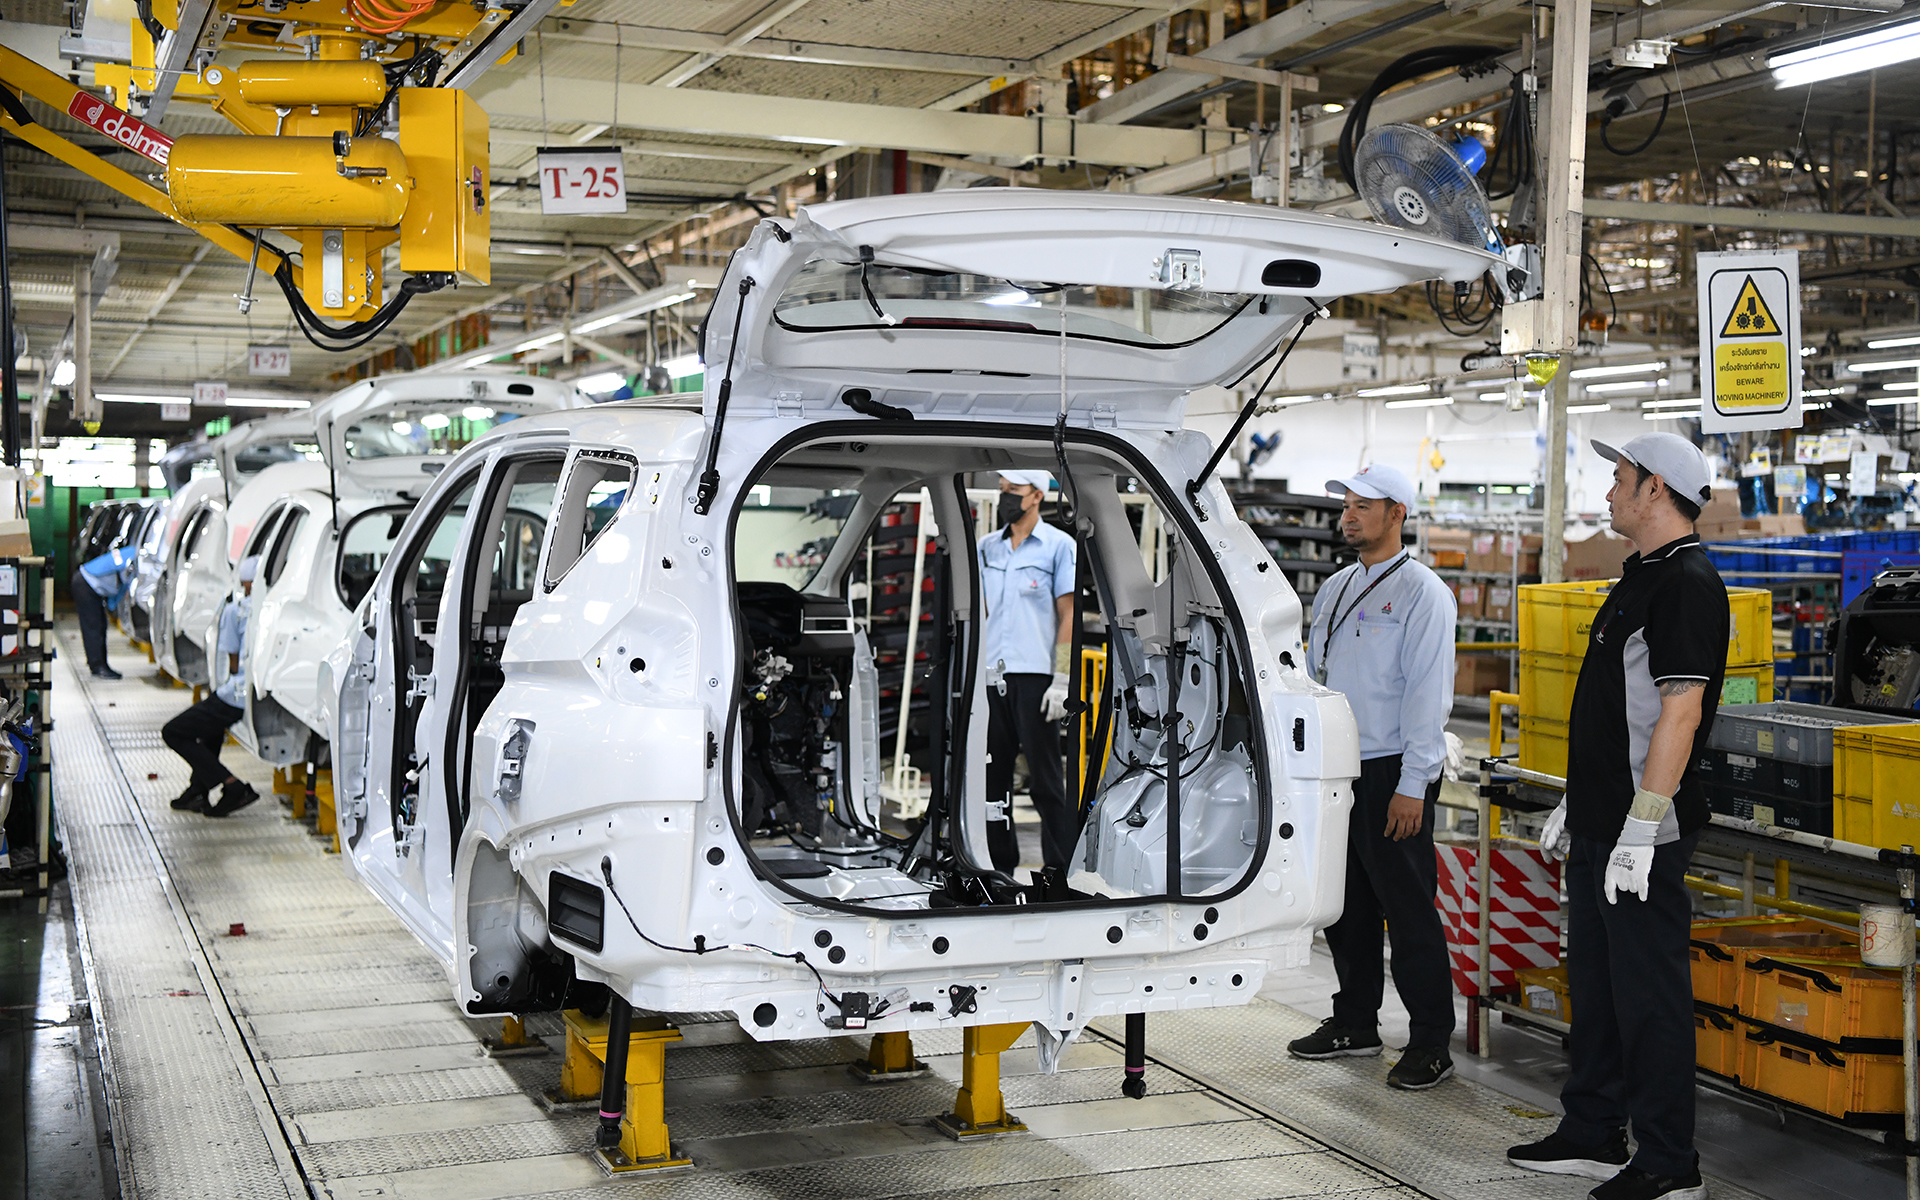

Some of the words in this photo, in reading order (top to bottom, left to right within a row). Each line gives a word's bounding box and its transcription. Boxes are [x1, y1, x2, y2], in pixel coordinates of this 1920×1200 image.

[544, 166, 619, 199] T-25
[253, 352, 287, 370] T-27
[1717, 393, 1743, 401] MOVING
[1745, 391, 1784, 399] MACHINERY
[1863, 920, 1878, 952] B
